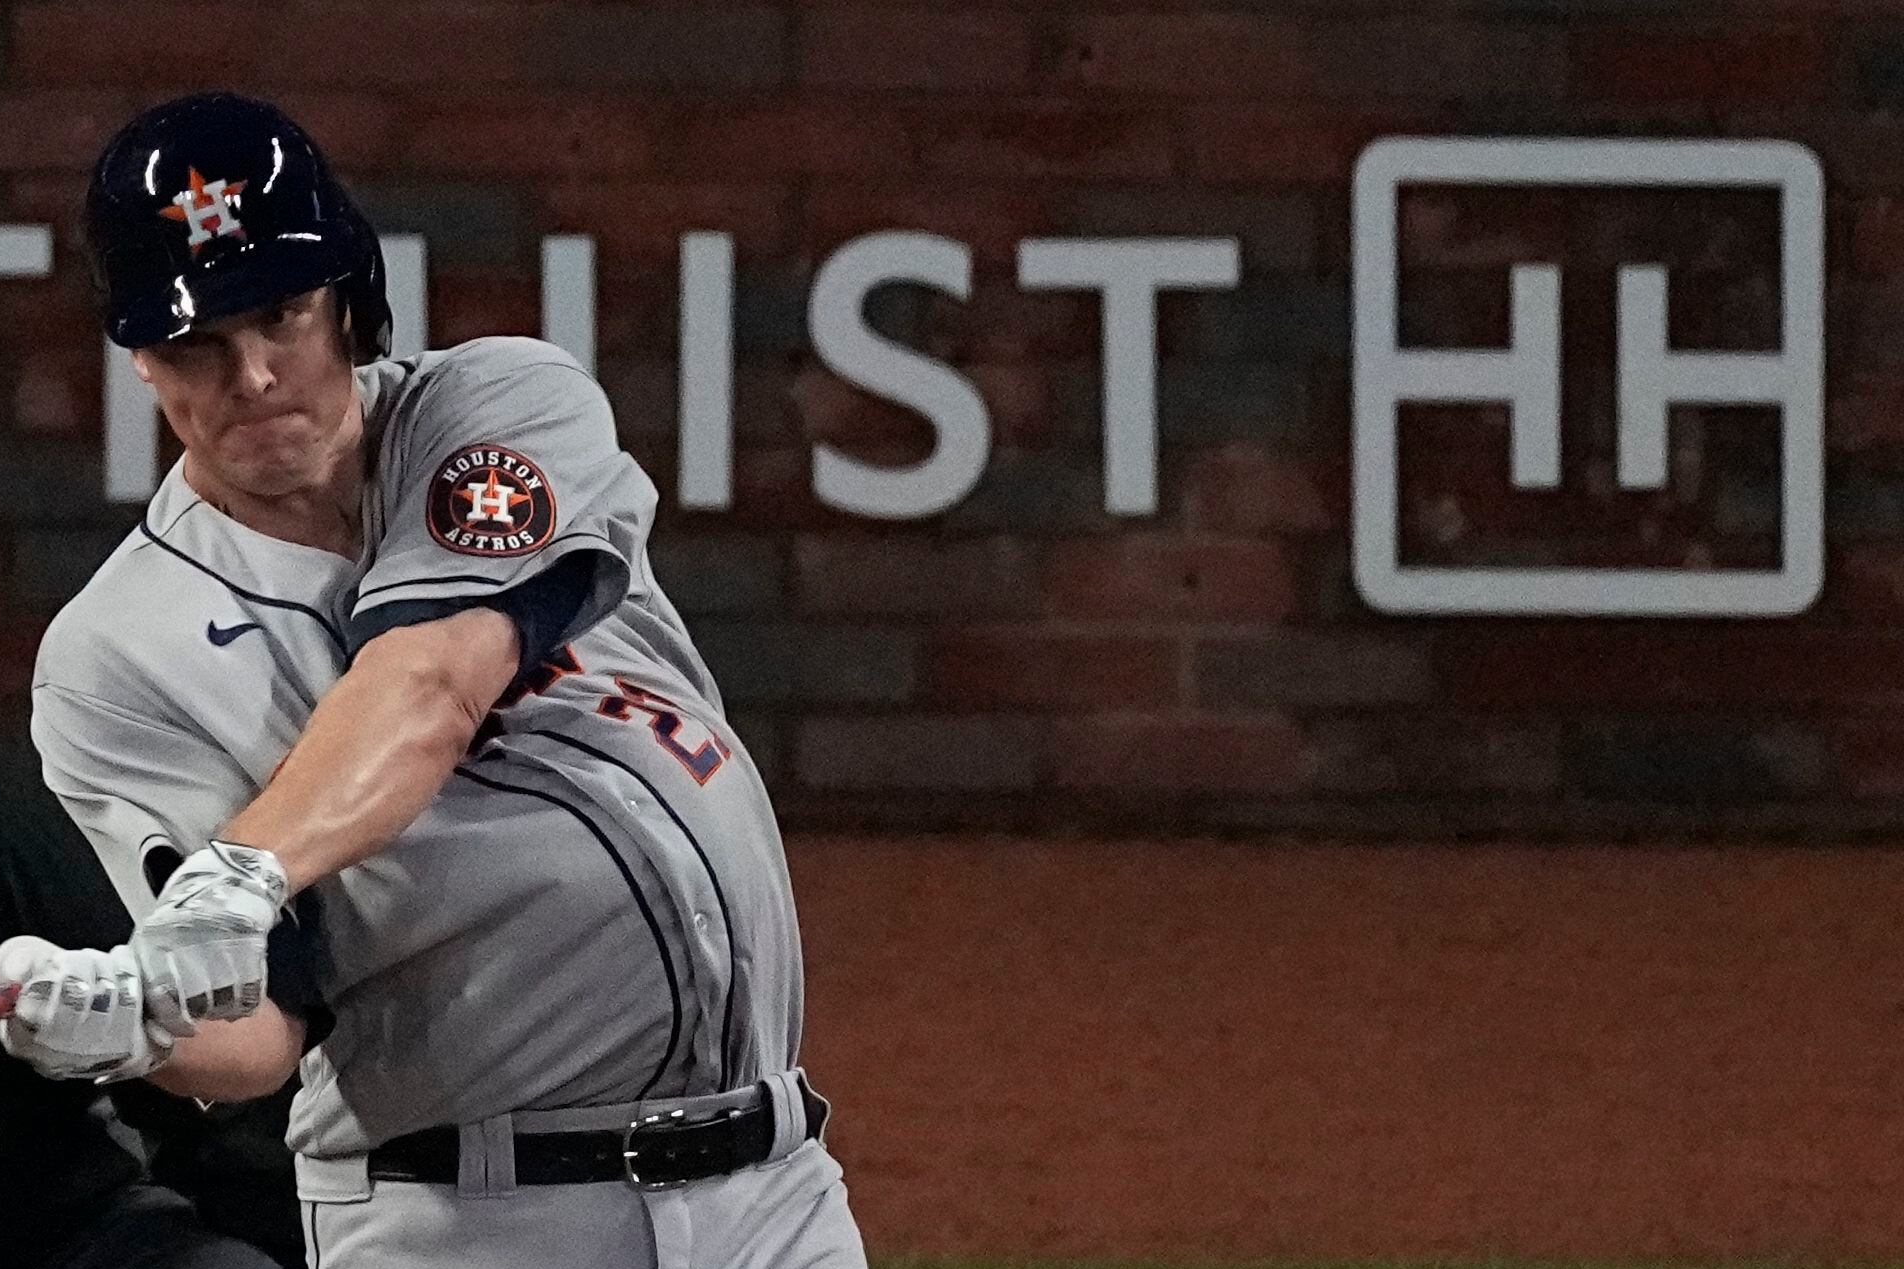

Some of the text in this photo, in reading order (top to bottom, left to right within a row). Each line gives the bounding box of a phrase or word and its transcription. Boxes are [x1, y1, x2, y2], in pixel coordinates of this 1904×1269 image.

[172, 178, 241, 246] H
[442, 451, 542, 490] HOUSTON
[466, 482, 516, 524] H
[445, 527, 534, 550] ASTROS
